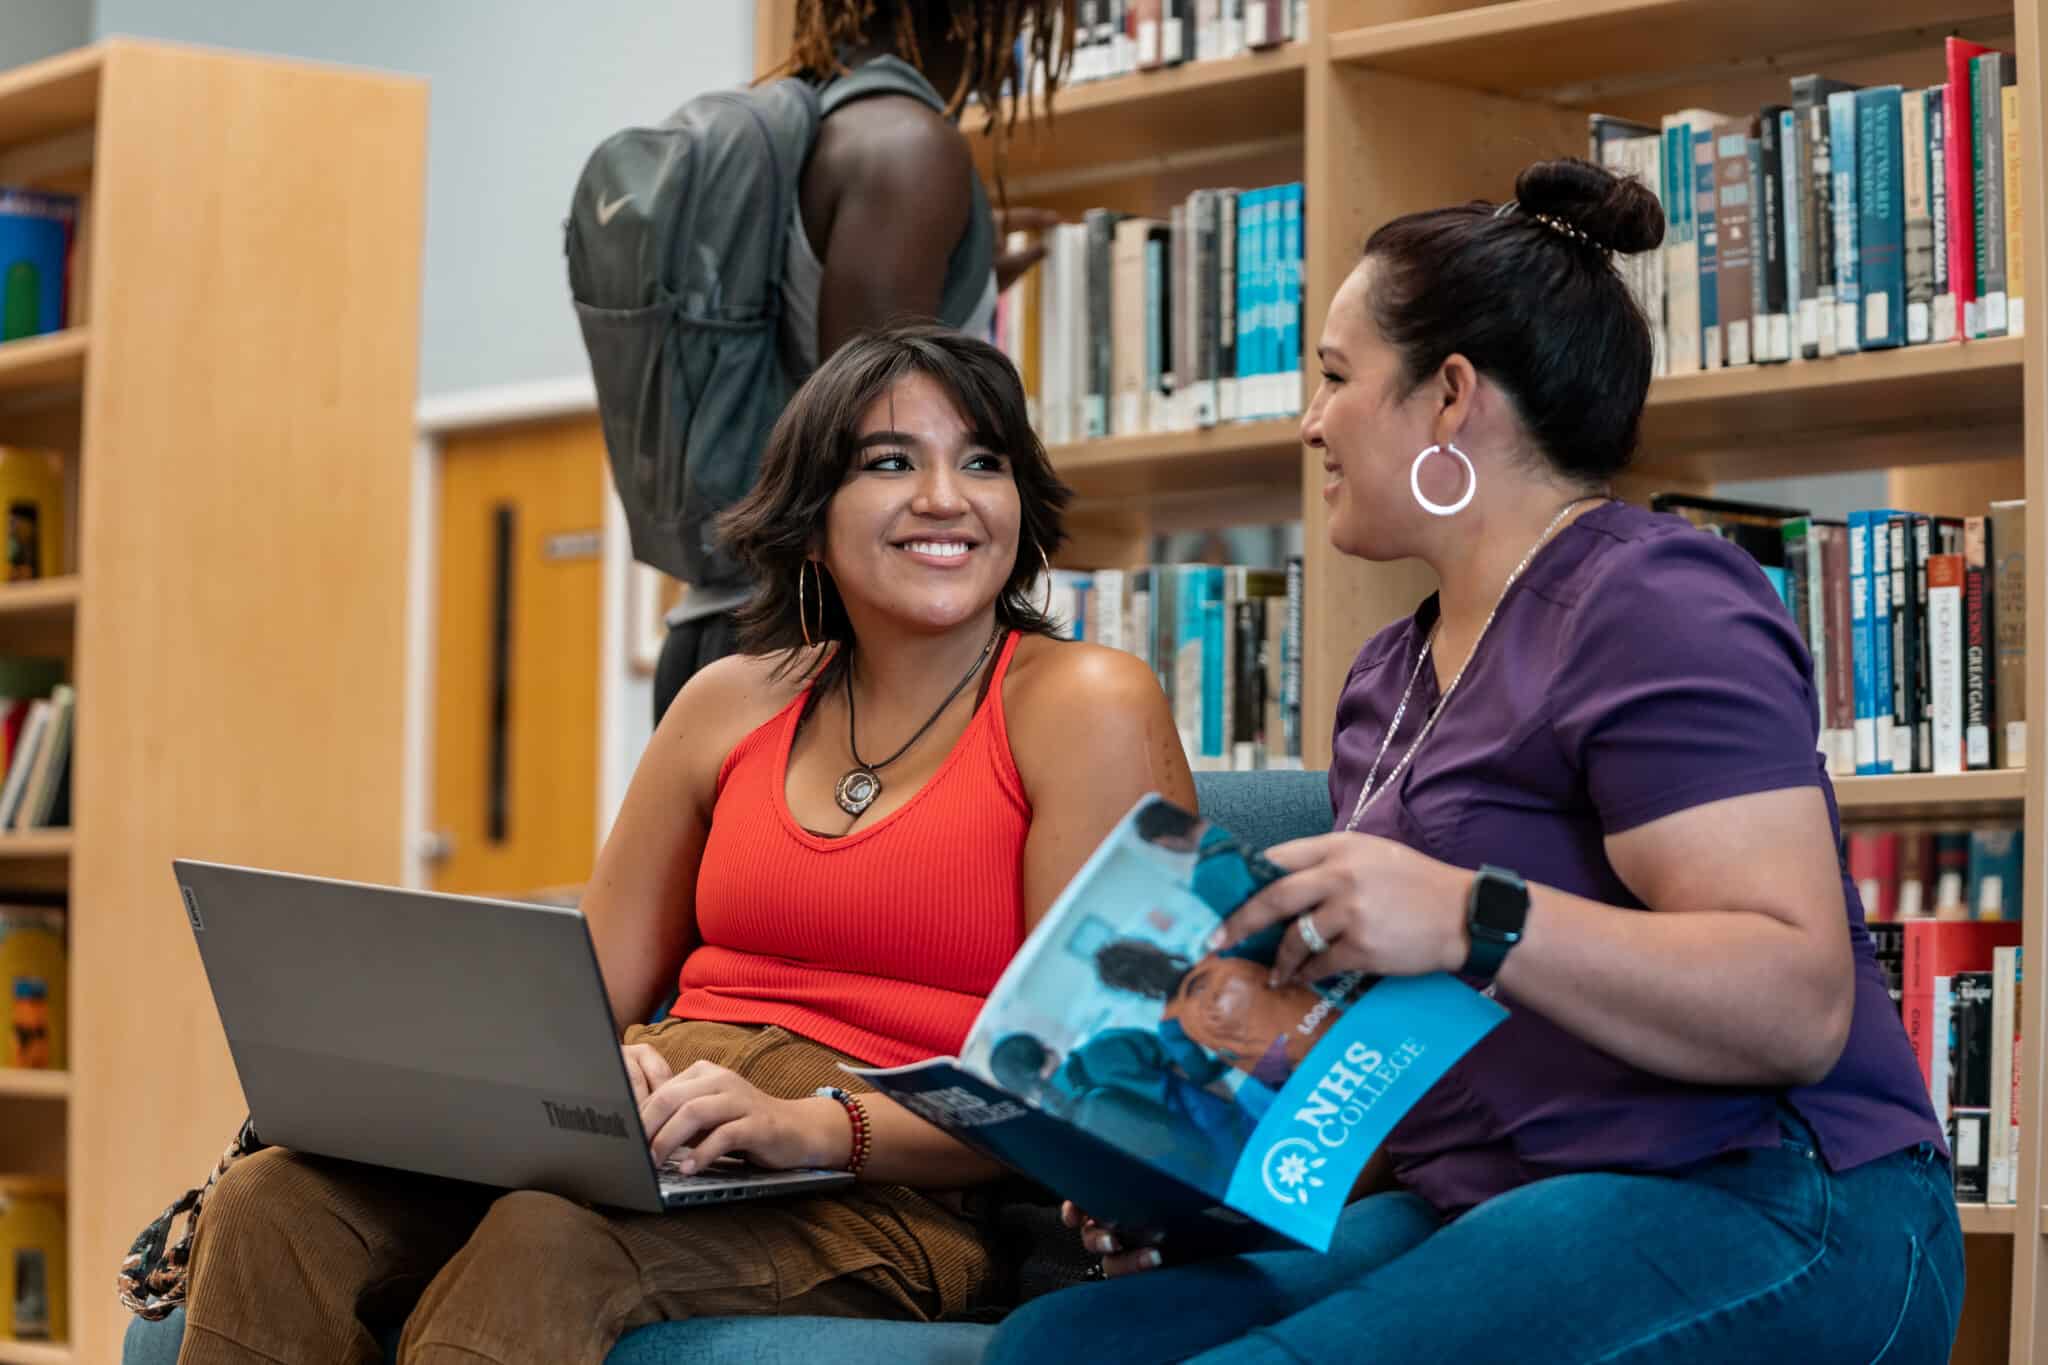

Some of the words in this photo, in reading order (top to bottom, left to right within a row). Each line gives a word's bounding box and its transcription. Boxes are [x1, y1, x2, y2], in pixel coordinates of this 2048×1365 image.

[1862, 107, 1876, 215] EXPANSION
[1876, 104, 1890, 218] WESTWARD
[1968, 646, 1983, 691] GREAT
[1296, 996, 1337, 1035] LOOK
[541, 1099, 631, 1139] ThinkBook
[1294, 1041, 1384, 1128] NHS
[1317, 1036, 1425, 1148] COLLEGE
